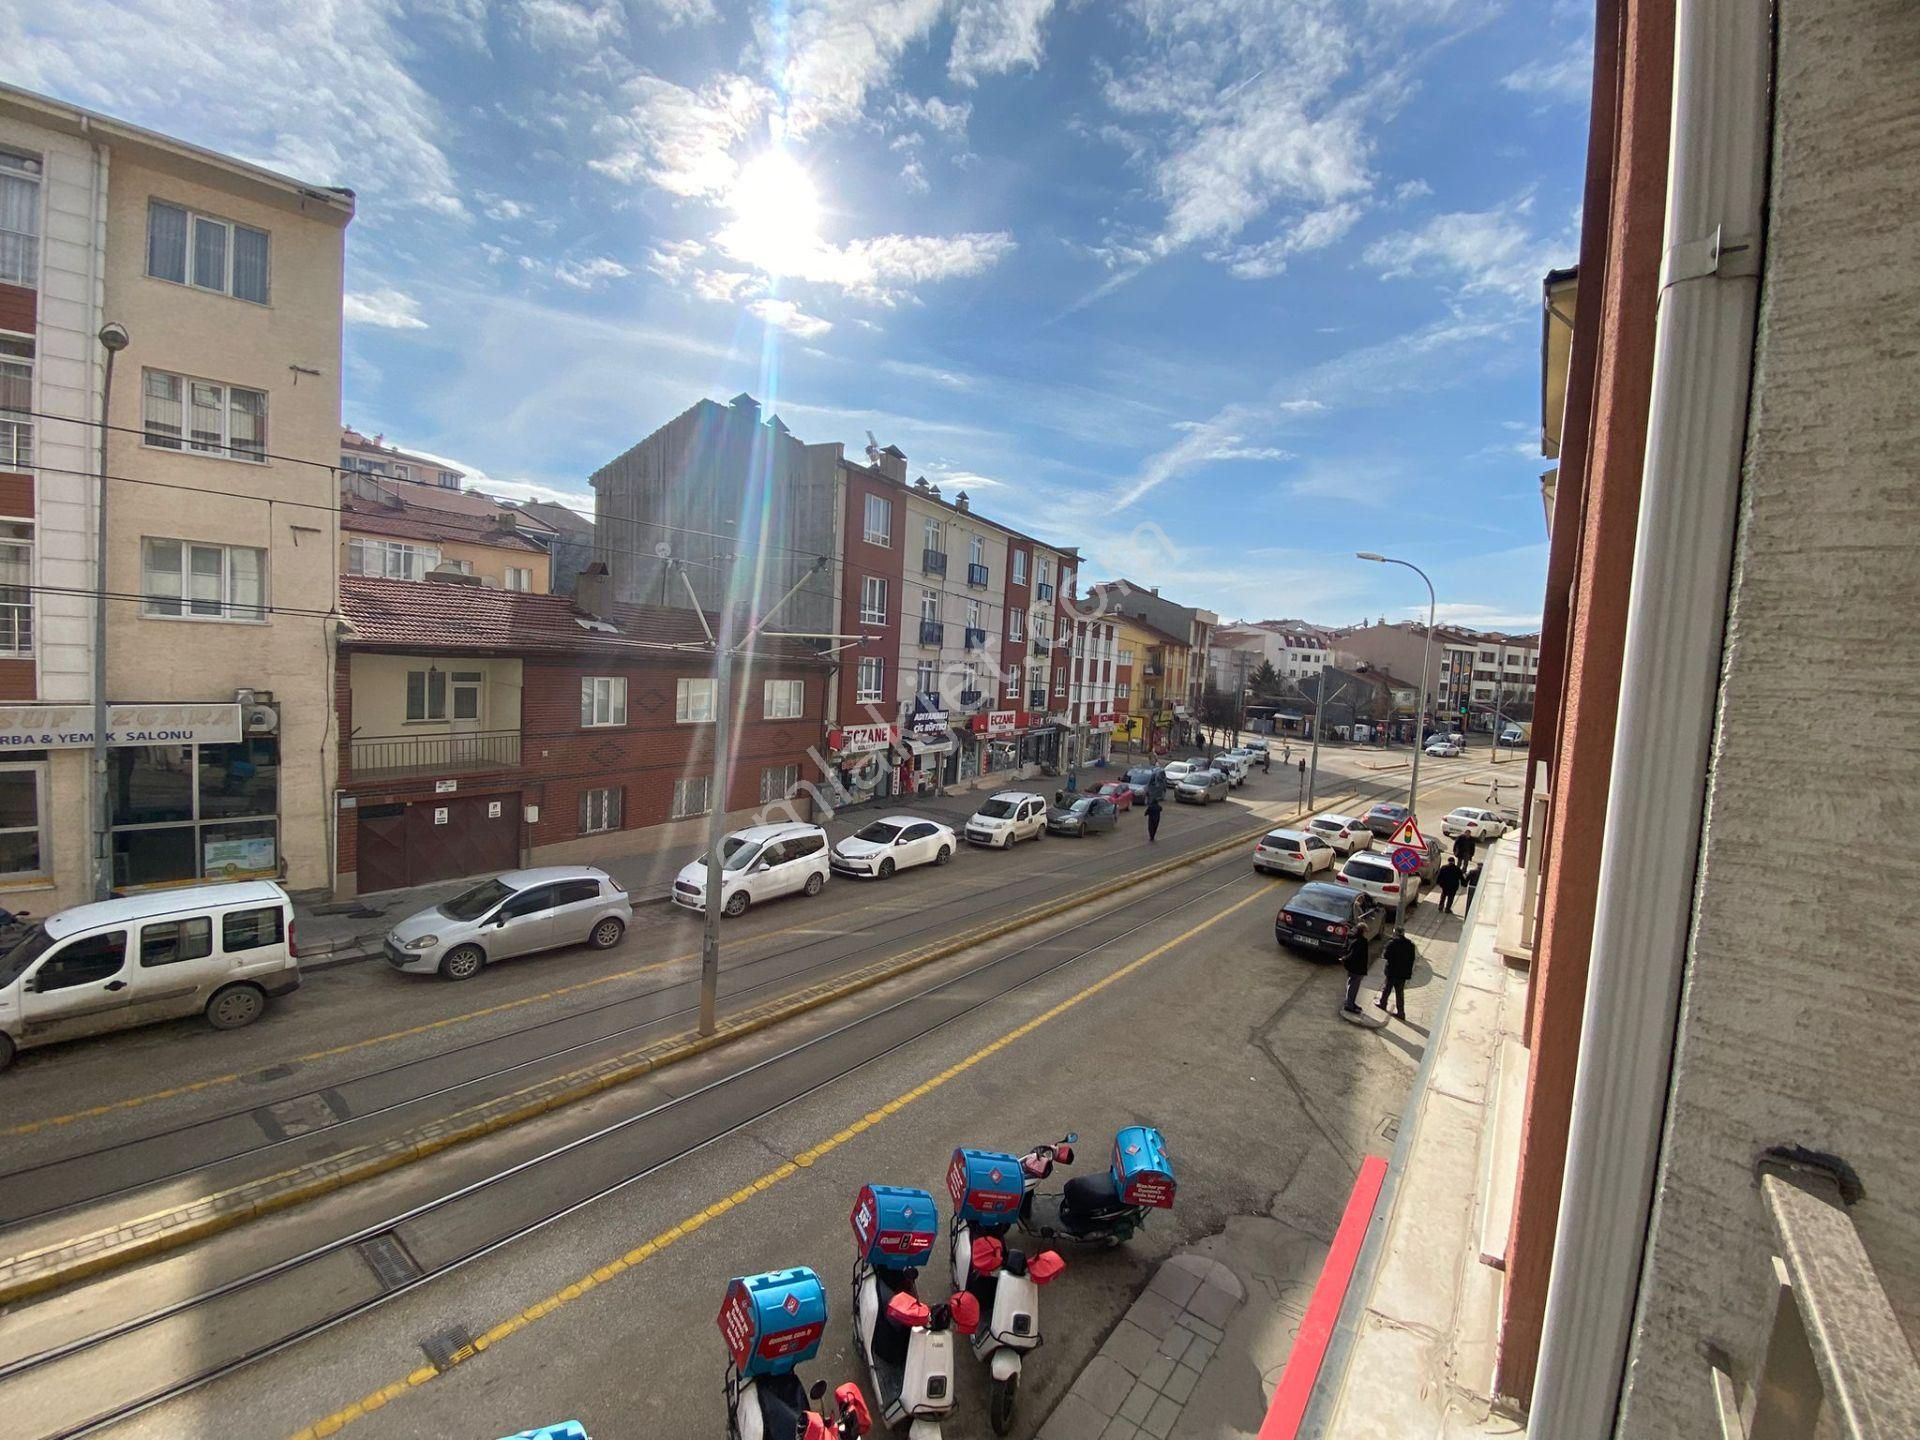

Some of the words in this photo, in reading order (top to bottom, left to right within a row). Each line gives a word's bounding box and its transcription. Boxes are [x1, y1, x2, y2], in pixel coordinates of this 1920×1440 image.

[107, 708, 233, 728] ZGARA
[991, 713, 1015, 725] ECZANE
[40, 734, 53, 744] &
[58, 732, 116, 744] YEMK
[126, 730, 194, 741] SALONU
